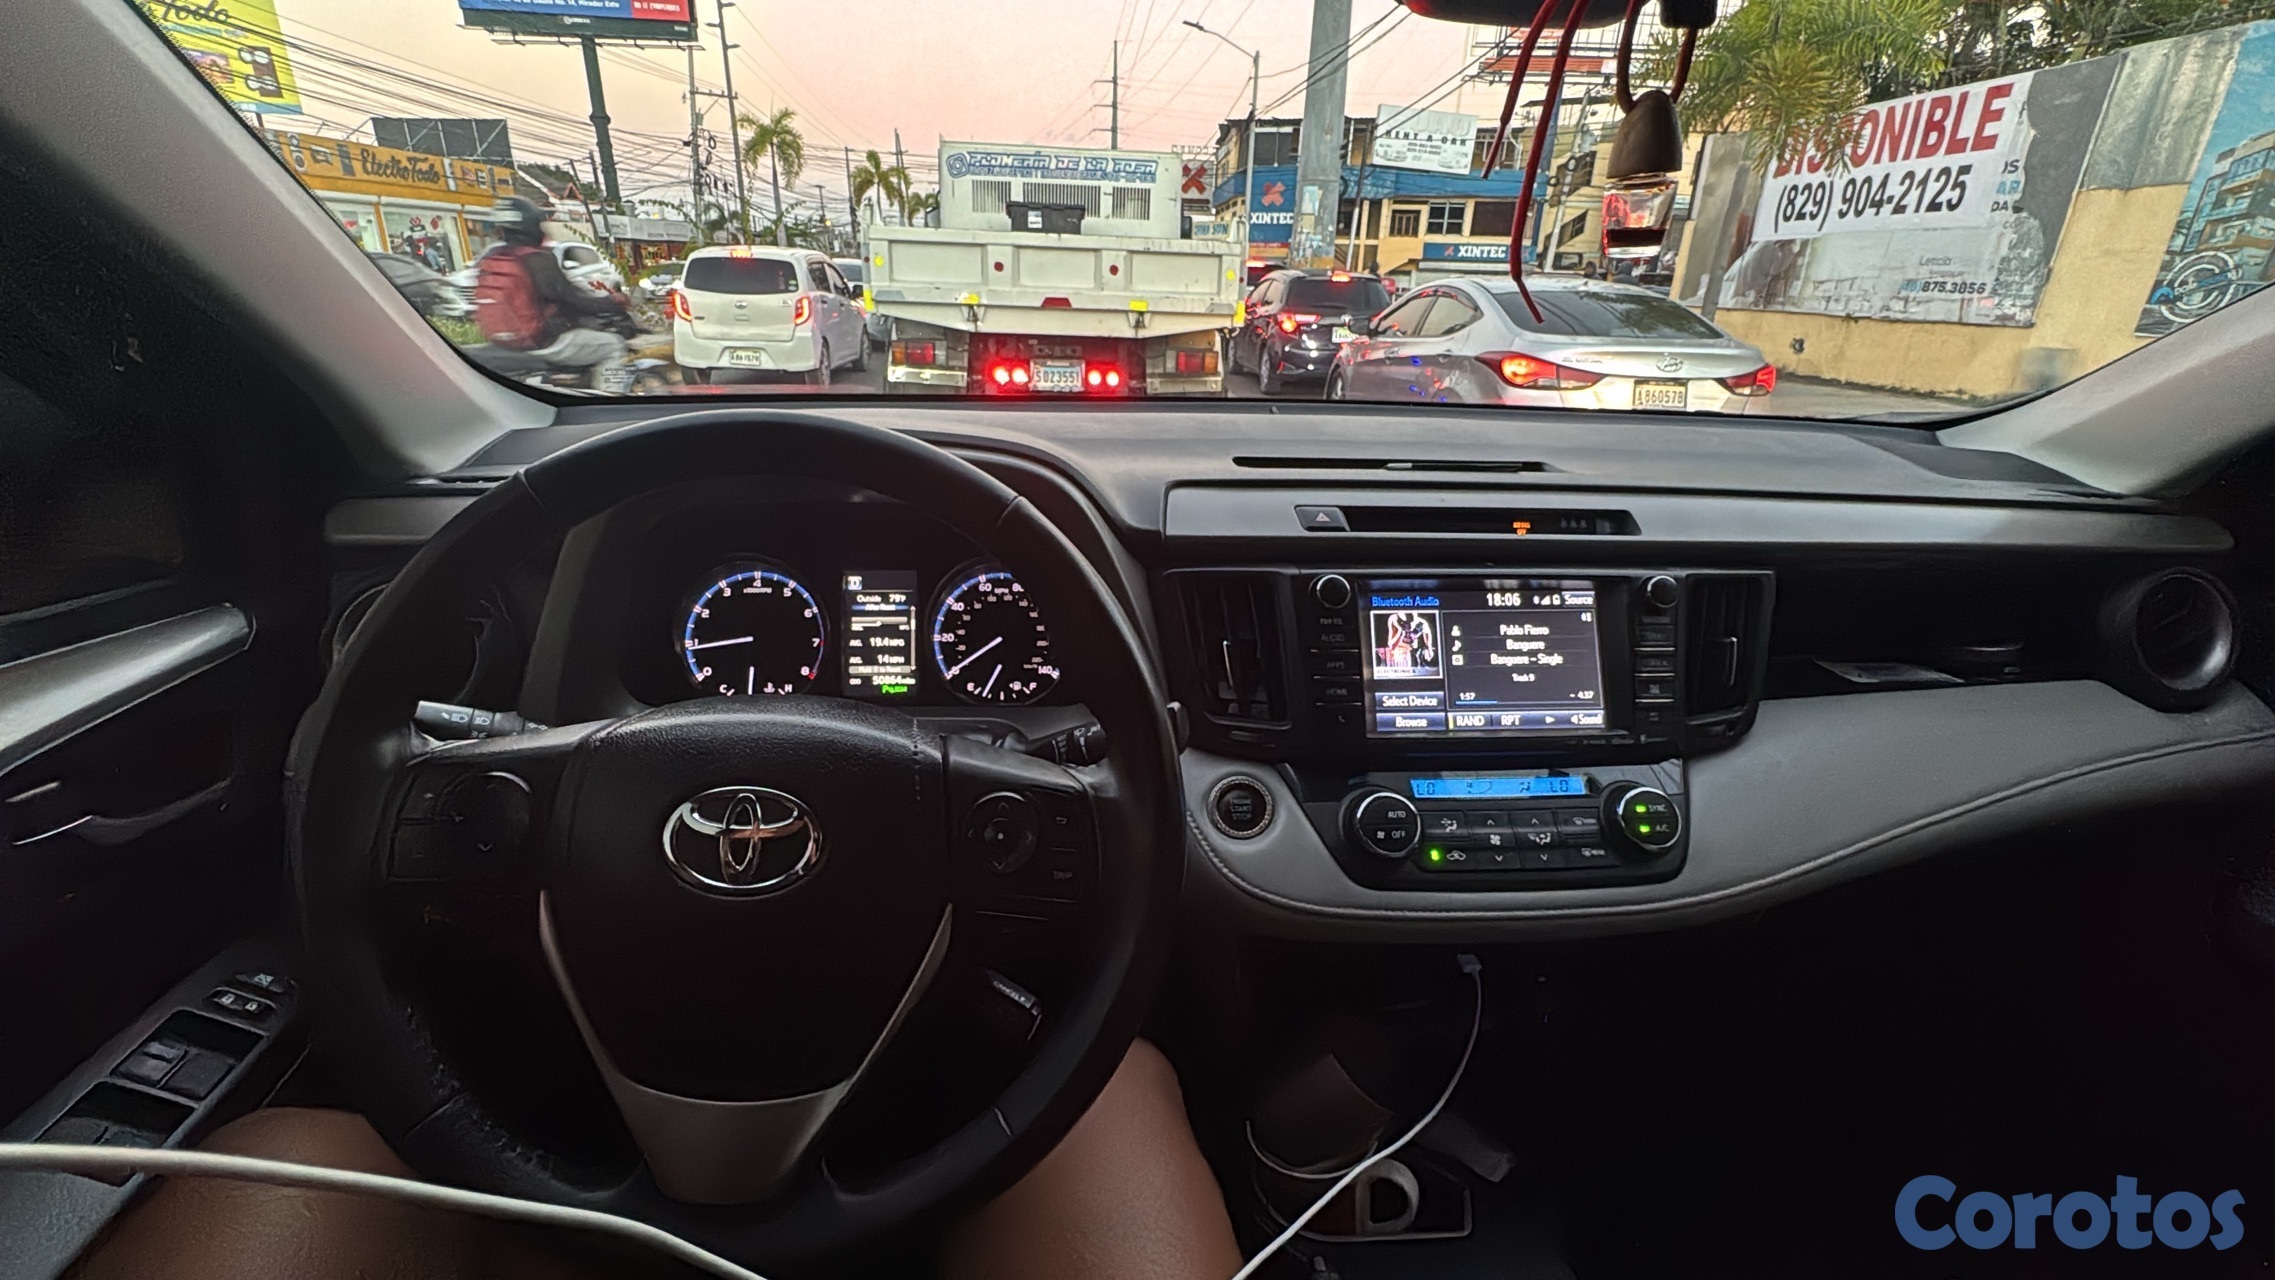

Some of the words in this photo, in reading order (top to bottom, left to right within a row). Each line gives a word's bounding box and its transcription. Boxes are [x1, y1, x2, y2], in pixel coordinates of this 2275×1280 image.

[1774, 179, 1835, 233] (829)
[1837, 164, 1973, 219] 904-2125
[1250, 212, 1295, 225] XINTEC
[1457, 245, 1507, 258] XINTEC
[1035, 370, 1080, 384] S023551
[1637, 390, 1684, 405] A860578
[753, 579, 762, 588] 4
[978, 582, 992, 592] 60
[722, 587, 731, 597] 3
[783, 587, 792, 597] 5
[1371, 596, 1413, 607] Bluetooth
[1414, 596, 1440, 607] Audio
[1485, 592, 1521, 606] 18:06
[1564, 594, 1594, 606] Source
[951, 602, 965, 611] 40
[701, 608, 710, 618] 2
[803, 608, 813, 618] 6
[1499, 624, 1524, 636] Pablo
[811, 638, 820, 647] 7
[870, 637, 889, 647] 19.4
[941, 633, 955, 642] 20
[877, 654, 889, 664] 14
[1537, 652, 1563, 667] Single
[702, 666, 712, 677] 0
[800, 666, 809, 676] 8
[1038, 666, 1053, 675] 140
[719, 684, 728, 694] C
[784, 683, 793, 693] H
[966, 682, 975, 692] E
[1029, 682, 1038, 690] F
[1382, 695, 1408, 707] Select
[1409, 695, 1438, 707] Device
[1395, 716, 1428, 728] Browse
[1456, 716, 1485, 727] RAND
[1501, 715, 1521, 726] RPT
[1578, 714, 1603, 725] Sound
[1387, 810, 1406, 819] AUTO
[1391, 830, 1406, 839] OFF
